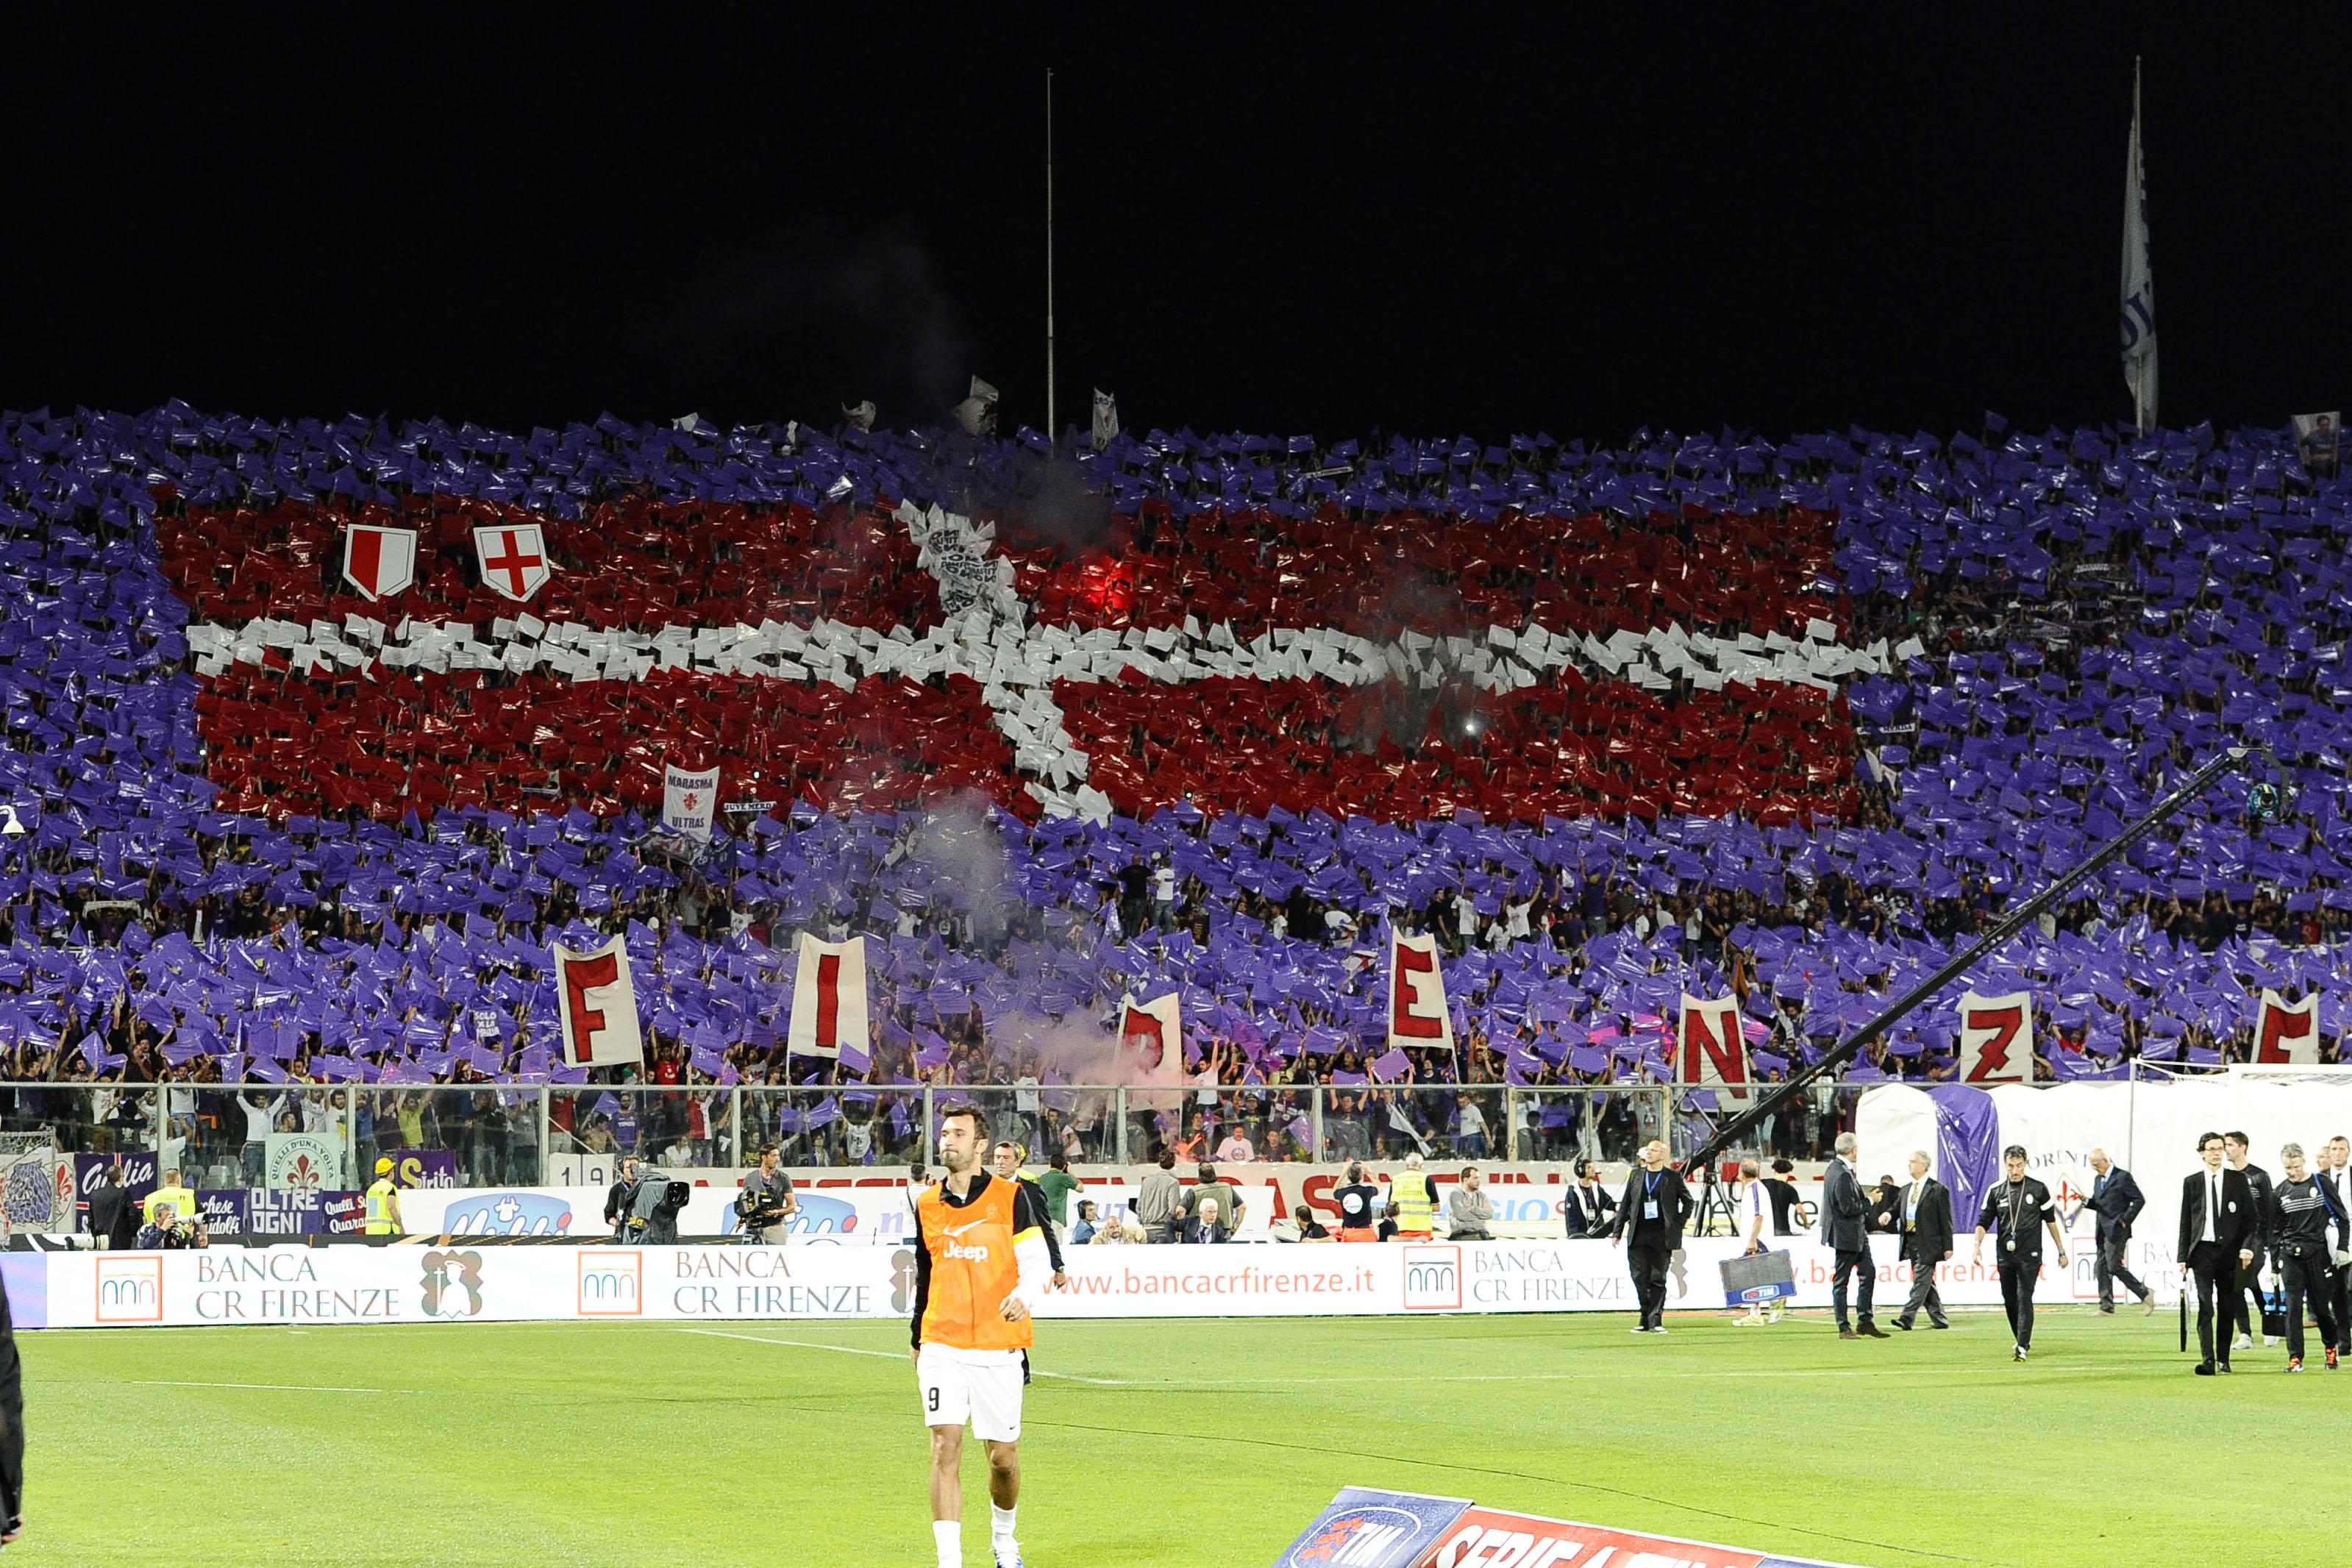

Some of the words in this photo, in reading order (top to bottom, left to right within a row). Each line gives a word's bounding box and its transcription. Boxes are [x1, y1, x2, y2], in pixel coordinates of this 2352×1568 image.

[668, 774, 713, 789] MARASMA
[671, 816, 705, 829] ULTRAS
[474, 1011, 496, 1020] SOLO
[564, 952, 618, 1063] F
[816, 955, 839, 1047] I
[1394, 943, 1442, 1038] E
[1683, 1009, 1749, 1099] N
[1966, 1005, 2023, 1083] Z
[272, 1147, 290, 1180] QUELLI
[291, 1140, 317, 1150] D'UNA
[320, 1148, 334, 1178] VOLTA
[251, 1188, 319, 1211] OLTRE
[324, 1198, 355, 1215] Quelli
[252, 1211, 302, 1234] OGNI
[944, 1240, 988, 1263] Jeep
[1475, 1250, 1563, 1273] BANCA
[198, 1254, 317, 1283] BANCA
[676, 1251, 791, 1277] BANCA
[674, 1286, 723, 1314] CR
[737, 1286, 870, 1313] FIRENZE
[1473, 1279, 1511, 1302] CR
[1522, 1277, 1627, 1300] FIRENZE
[196, 1291, 246, 1319] CR
[261, 1289, 400, 1318] FIRENZE
[928, 1387, 939, 1411] 9
[1330, 1522, 1405, 1567] TIM
